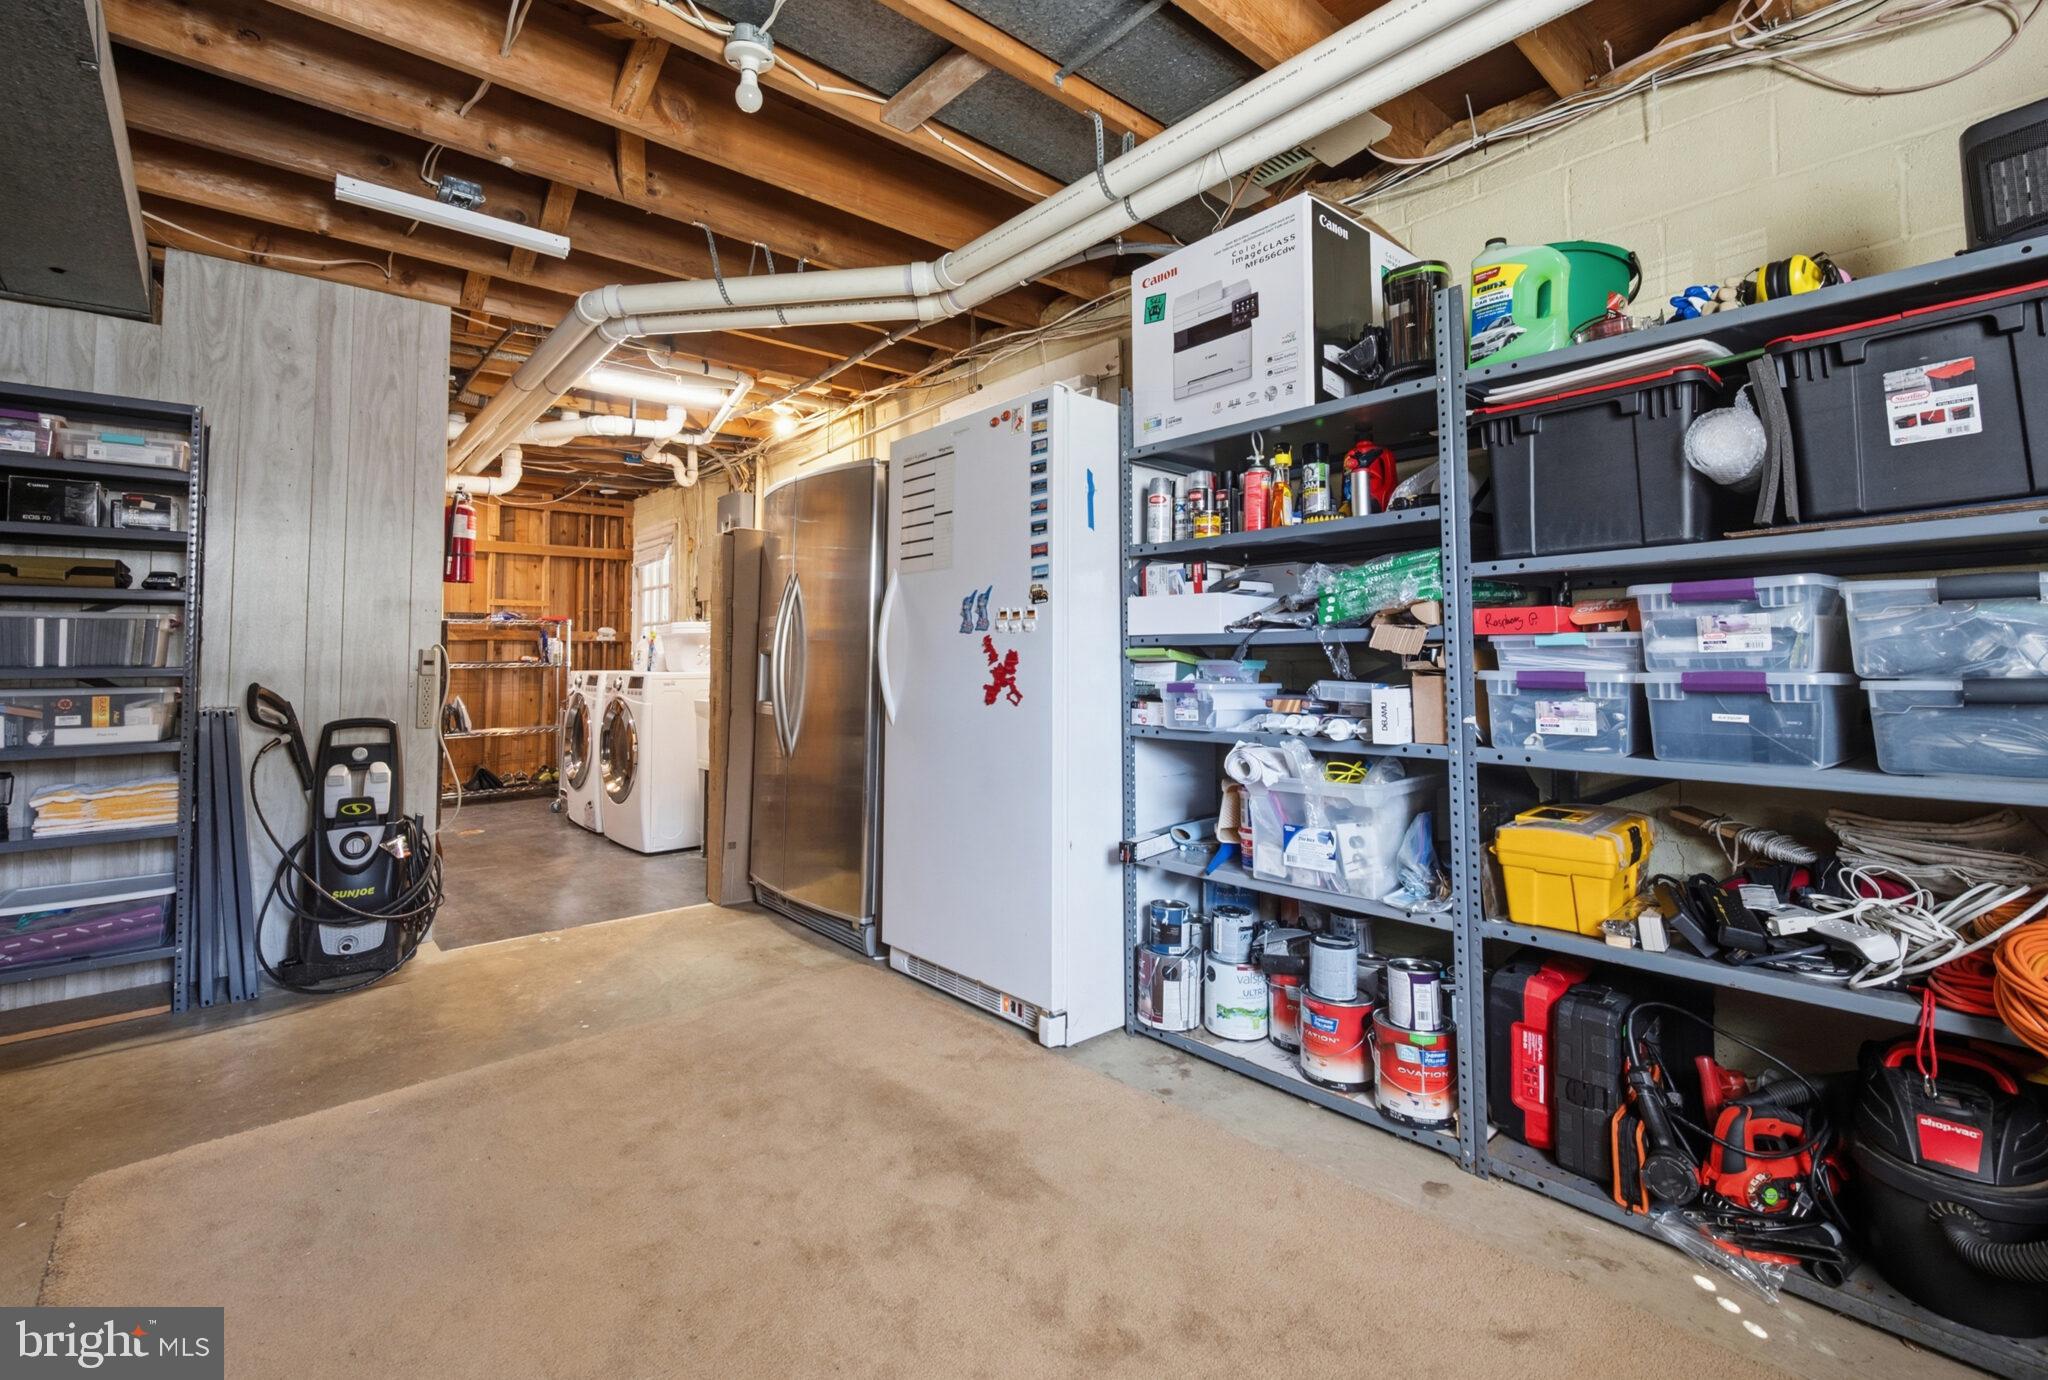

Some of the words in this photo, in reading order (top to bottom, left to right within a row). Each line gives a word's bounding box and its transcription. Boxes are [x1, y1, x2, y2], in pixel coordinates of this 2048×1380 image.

[1319, 214, 1349, 240] Canon
[1231, 233, 1296, 265] imageCLASS
[1231, 241, 1262, 258] Color
[1245, 245, 1296, 269] MF656Cdw
[1142, 267, 1178, 289] Canon
[1397, 1066, 1450, 1079] OVATION
